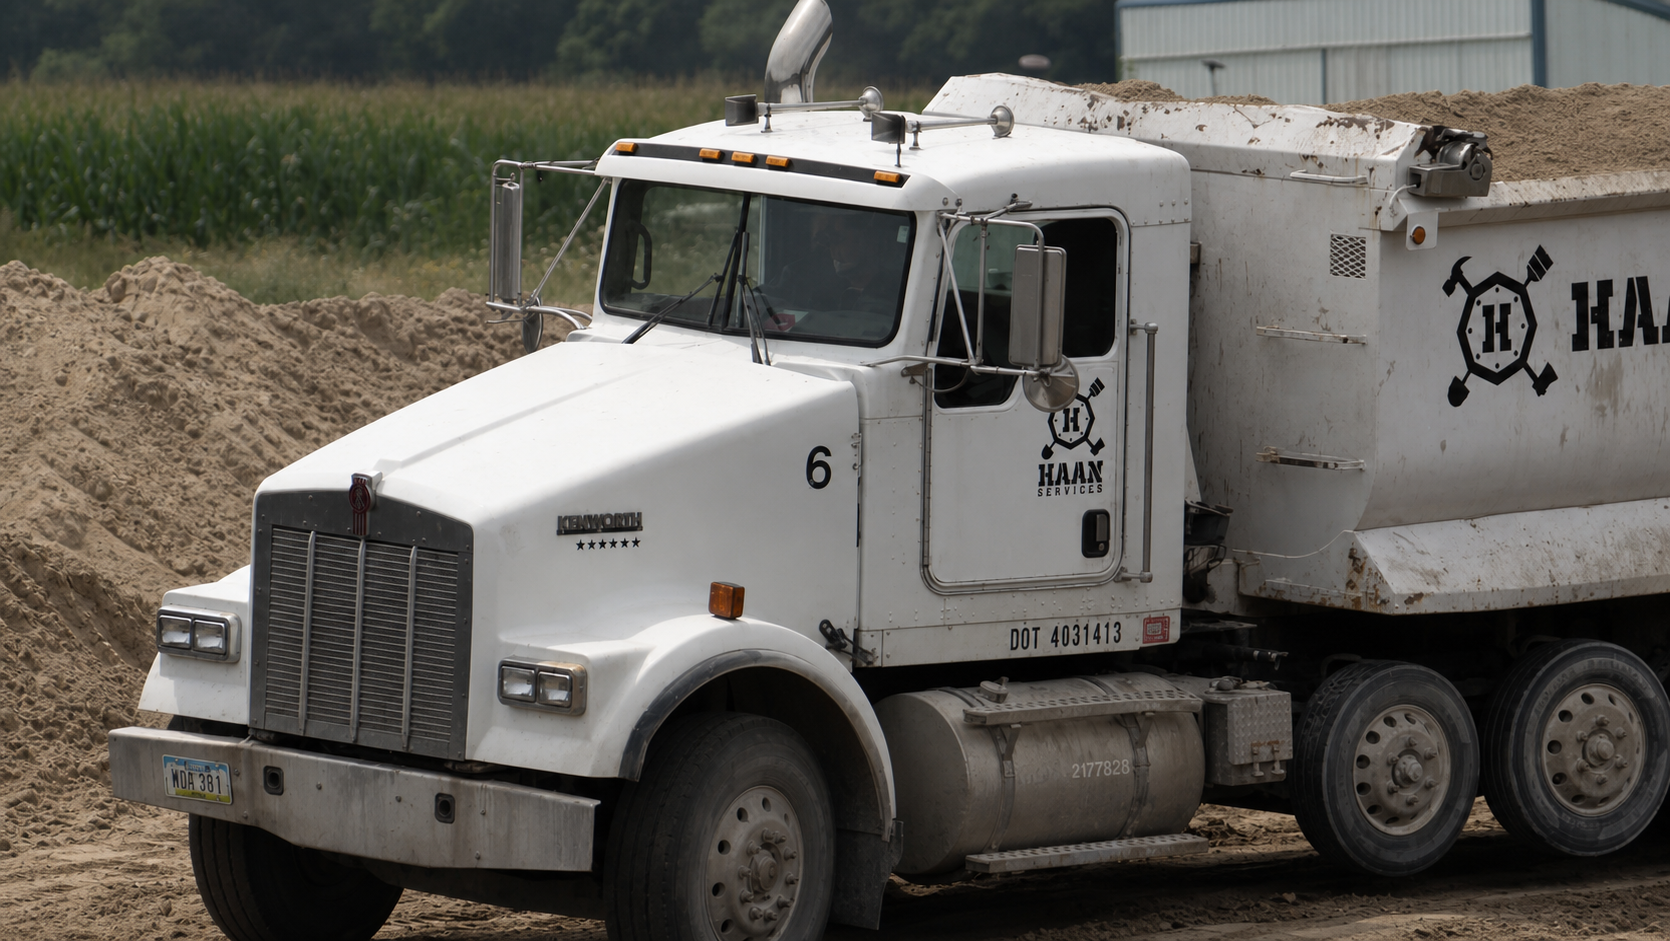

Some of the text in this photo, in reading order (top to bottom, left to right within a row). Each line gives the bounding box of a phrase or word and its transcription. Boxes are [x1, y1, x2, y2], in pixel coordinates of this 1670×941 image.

[1571, 276, 1670, 352] HA
[1482, 303, 1512, 353] H
[1063, 407, 1080, 432] H
[806, 445, 832, 489] 6
[1038, 460, 1103, 487] HAAN
[1038, 484, 1103, 497] SERVICES
[557, 511, 643, 531] KENWORTH
[1010, 627, 1041, 651] DOT
[1051, 621, 1122, 648] 4031413
[1072, 759, 1130, 777] 2177828
[199, 773, 221, 795] 381
